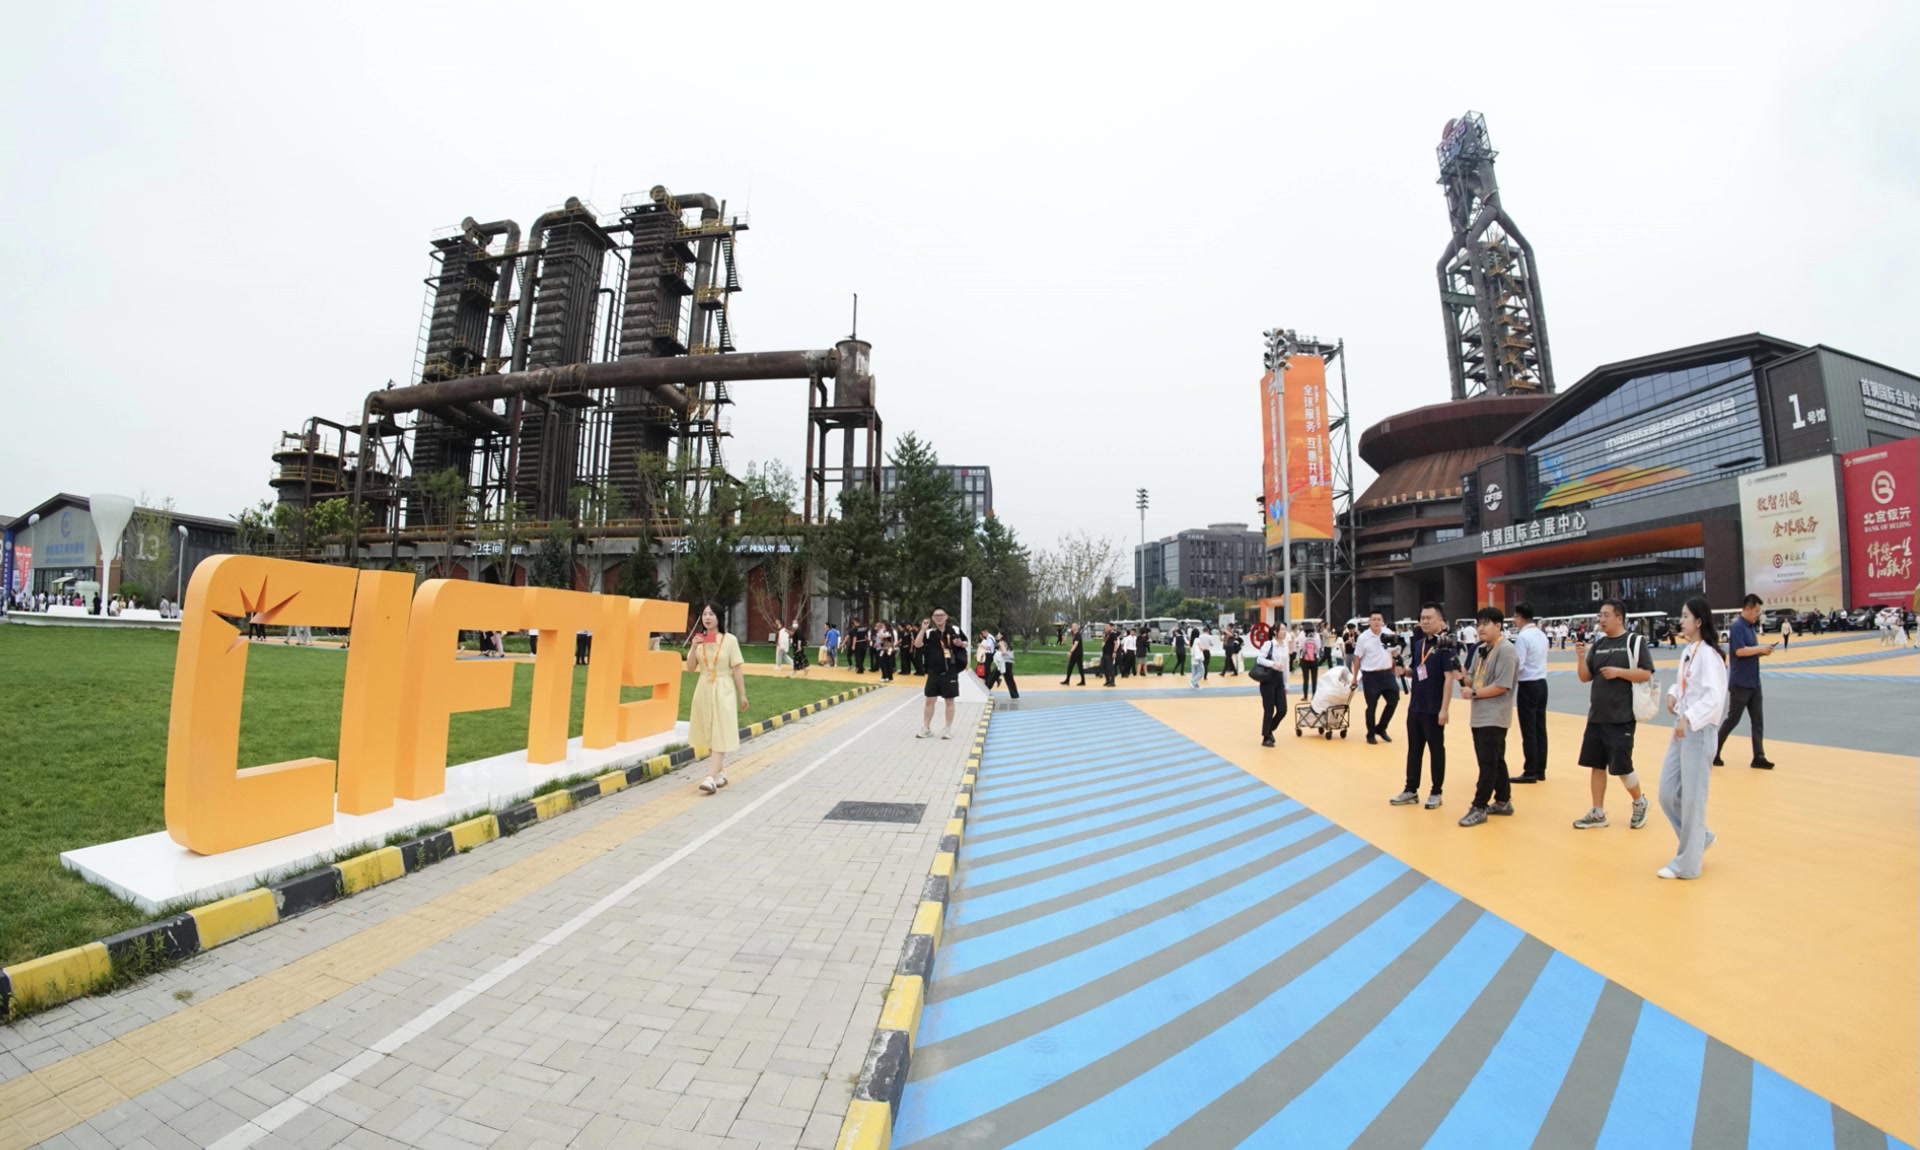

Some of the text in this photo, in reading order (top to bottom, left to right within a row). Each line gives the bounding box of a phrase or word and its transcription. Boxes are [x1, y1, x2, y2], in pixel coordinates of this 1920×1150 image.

[1860, 378, 1920, 410] 首钢国际会展中
[1481, 511, 1586, 548] 首钢国际会展中心
[1773, 516, 1818, 537] 全球服务
[1863, 507, 1911, 524] 北京银行
[165, 553, 689, 856] CIFTIS
